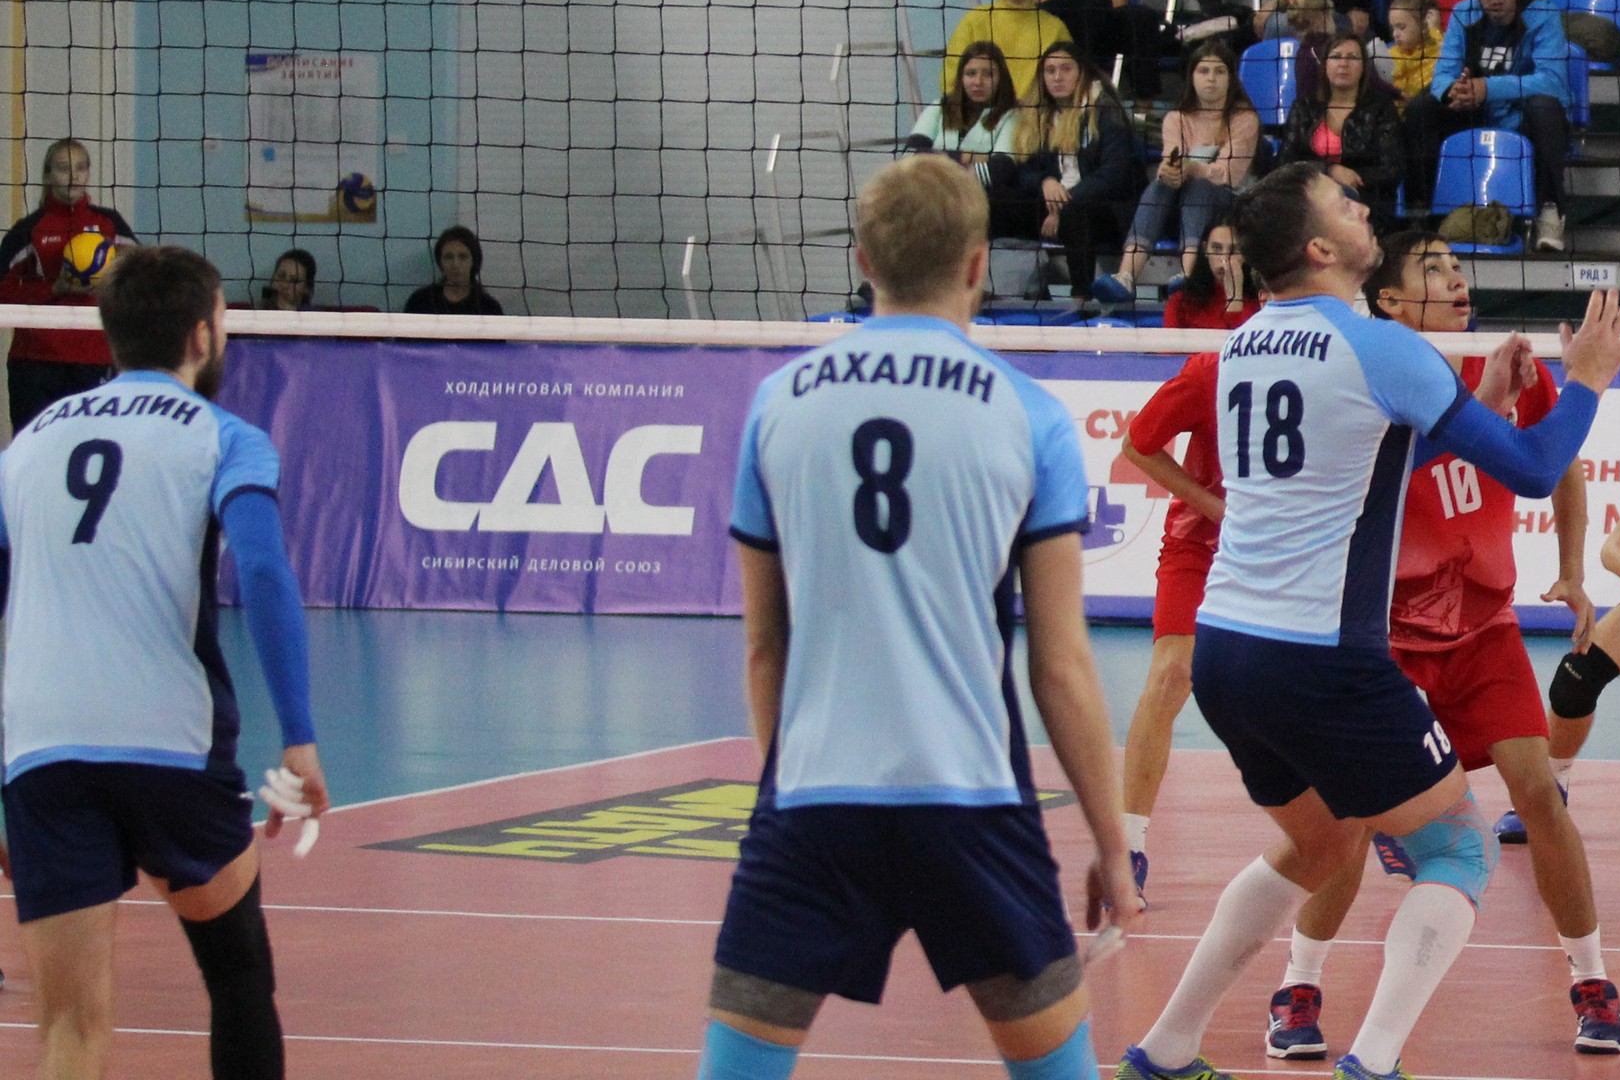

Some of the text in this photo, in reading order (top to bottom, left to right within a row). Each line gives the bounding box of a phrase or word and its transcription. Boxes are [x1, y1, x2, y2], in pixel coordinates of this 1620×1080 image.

[1580, 268, 1609, 281] РЯД 3
[445, 381, 686, 398] ХОЛДИНГОВАЯ КОМПАНИЯ
[791, 351, 998, 405] САХАЛИН
[32, 394, 202, 433] САХАЛИН
[1228, 379, 1306, 479] 18
[66, 438, 124, 545] 9
[851, 417, 915, 554] 8
[1431, 458, 1483, 520] 10
[421, 556, 662, 573] СИБИРСКИЙ ДЕЛОВОЙ СОЮЗ
[1423, 720, 1452, 765] 18
